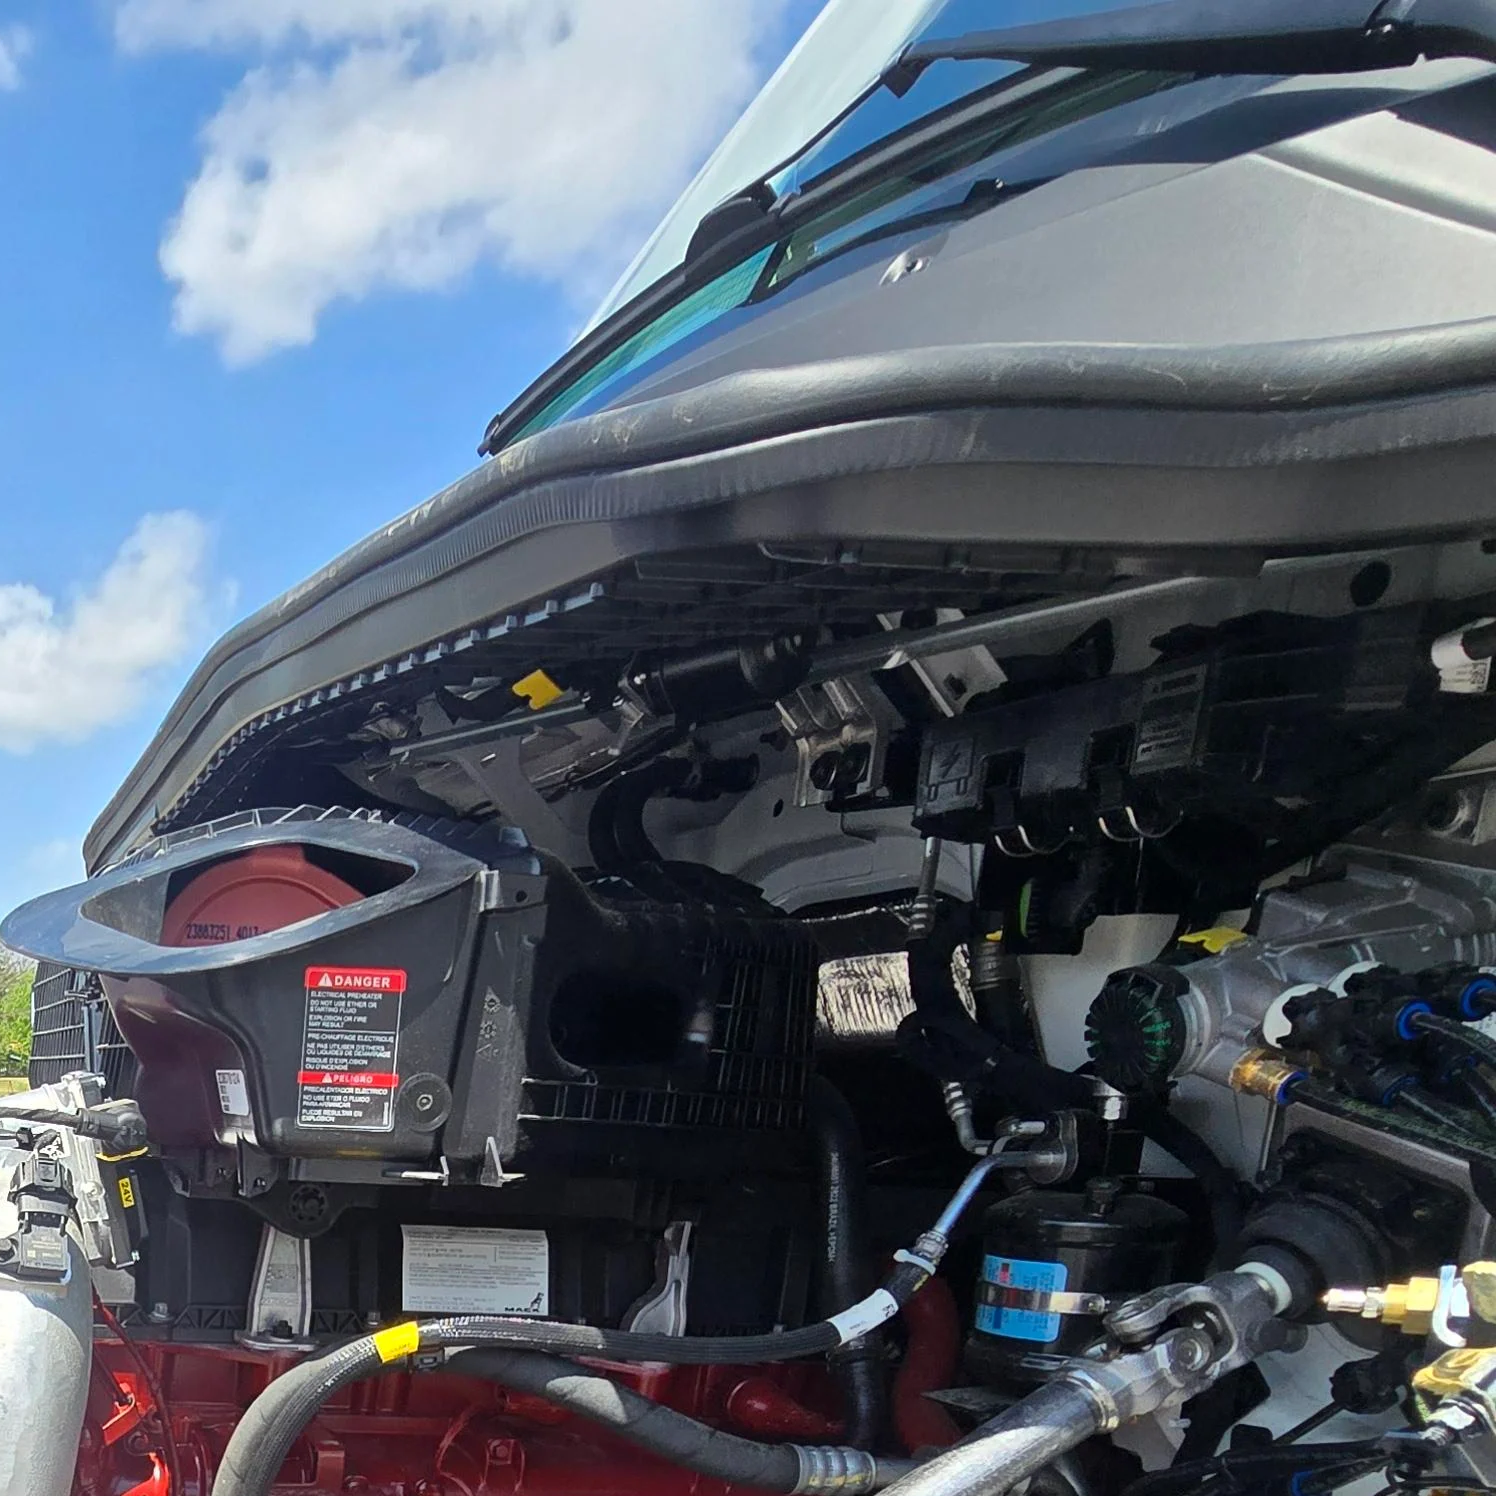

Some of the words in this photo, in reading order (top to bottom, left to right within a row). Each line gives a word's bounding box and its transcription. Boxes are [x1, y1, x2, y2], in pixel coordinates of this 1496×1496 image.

[334, 975, 391, 988] DANGER
[347, 992, 382, 1000] PREHEATER
[333, 1074, 373, 1083] PELIGRO
[121, 1181, 132, 1203] 24V
